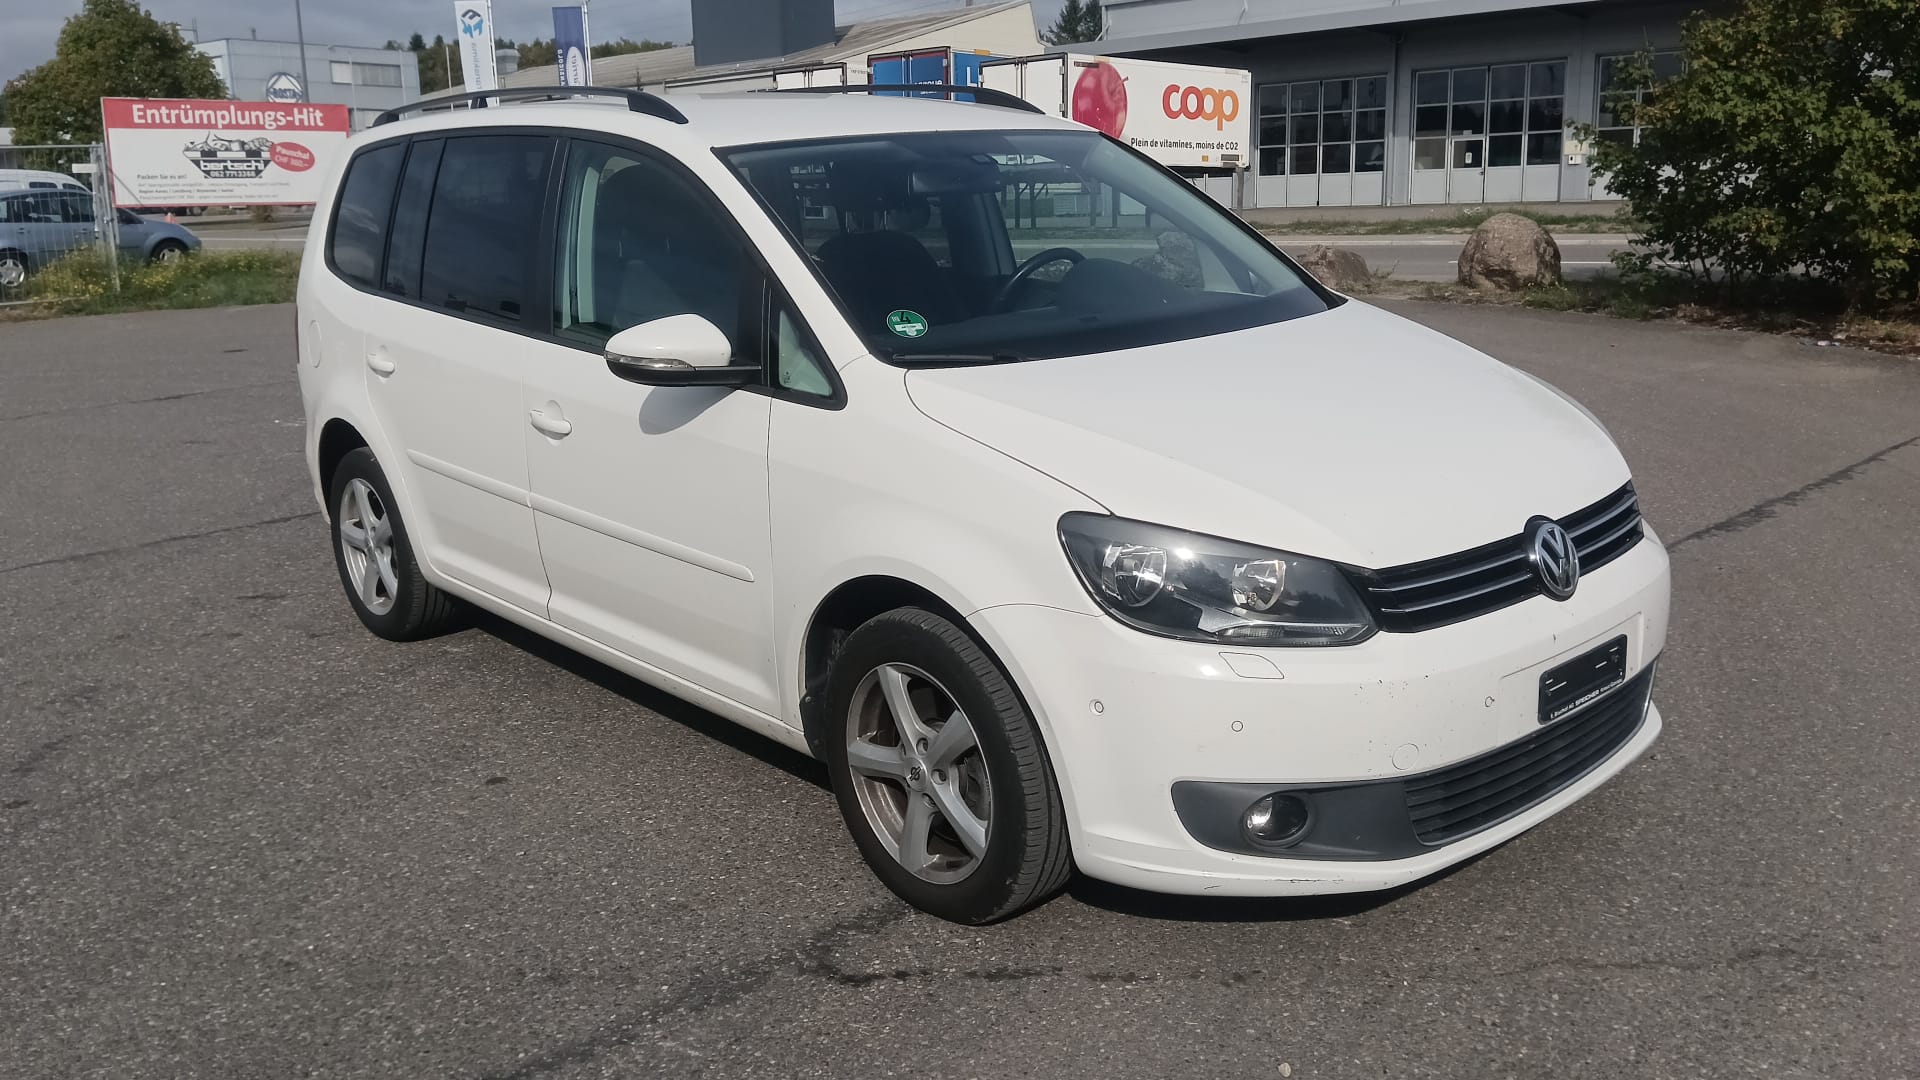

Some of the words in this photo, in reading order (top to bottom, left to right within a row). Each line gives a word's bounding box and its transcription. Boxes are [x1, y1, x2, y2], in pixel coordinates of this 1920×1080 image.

[132, 104, 324, 130] Entrümplungs-Hit
[1163, 84, 1239, 131] coop
[1130, 137, 1149, 148] Plein
[1150, 138, 1159, 148] de
[1159, 138, 1195, 150] vitamines,
[1195, 141, 1215, 150] moins
[1216, 141, 1225, 150] de
[1225, 141, 1239, 151] CO2
[200, 160, 265, 171] bertschi
